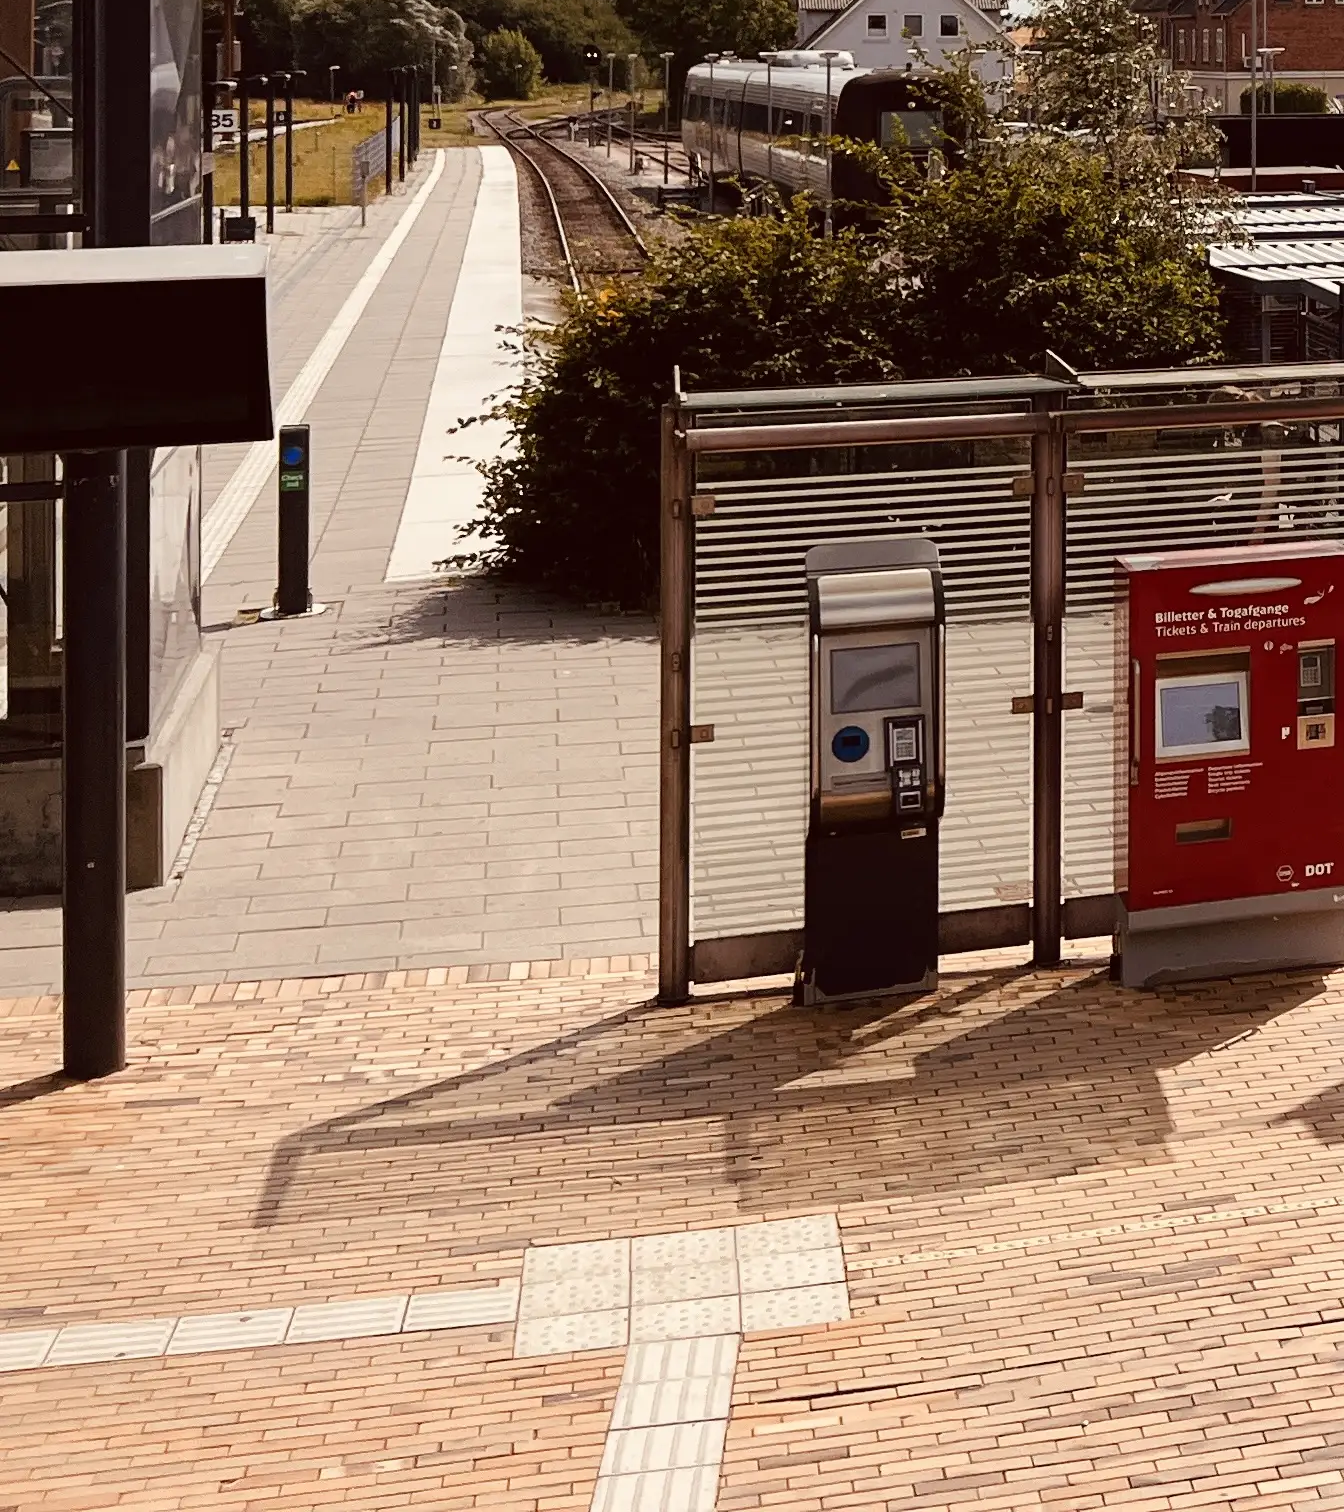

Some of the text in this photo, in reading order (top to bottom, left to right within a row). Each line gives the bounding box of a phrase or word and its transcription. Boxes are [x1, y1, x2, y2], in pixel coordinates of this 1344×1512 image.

[1155, 604, 1289, 624] Billetter & Togafgange
[1155, 616, 1306, 637] Tickets & Train departures
[1305, 862, 1333, 876] DOT
